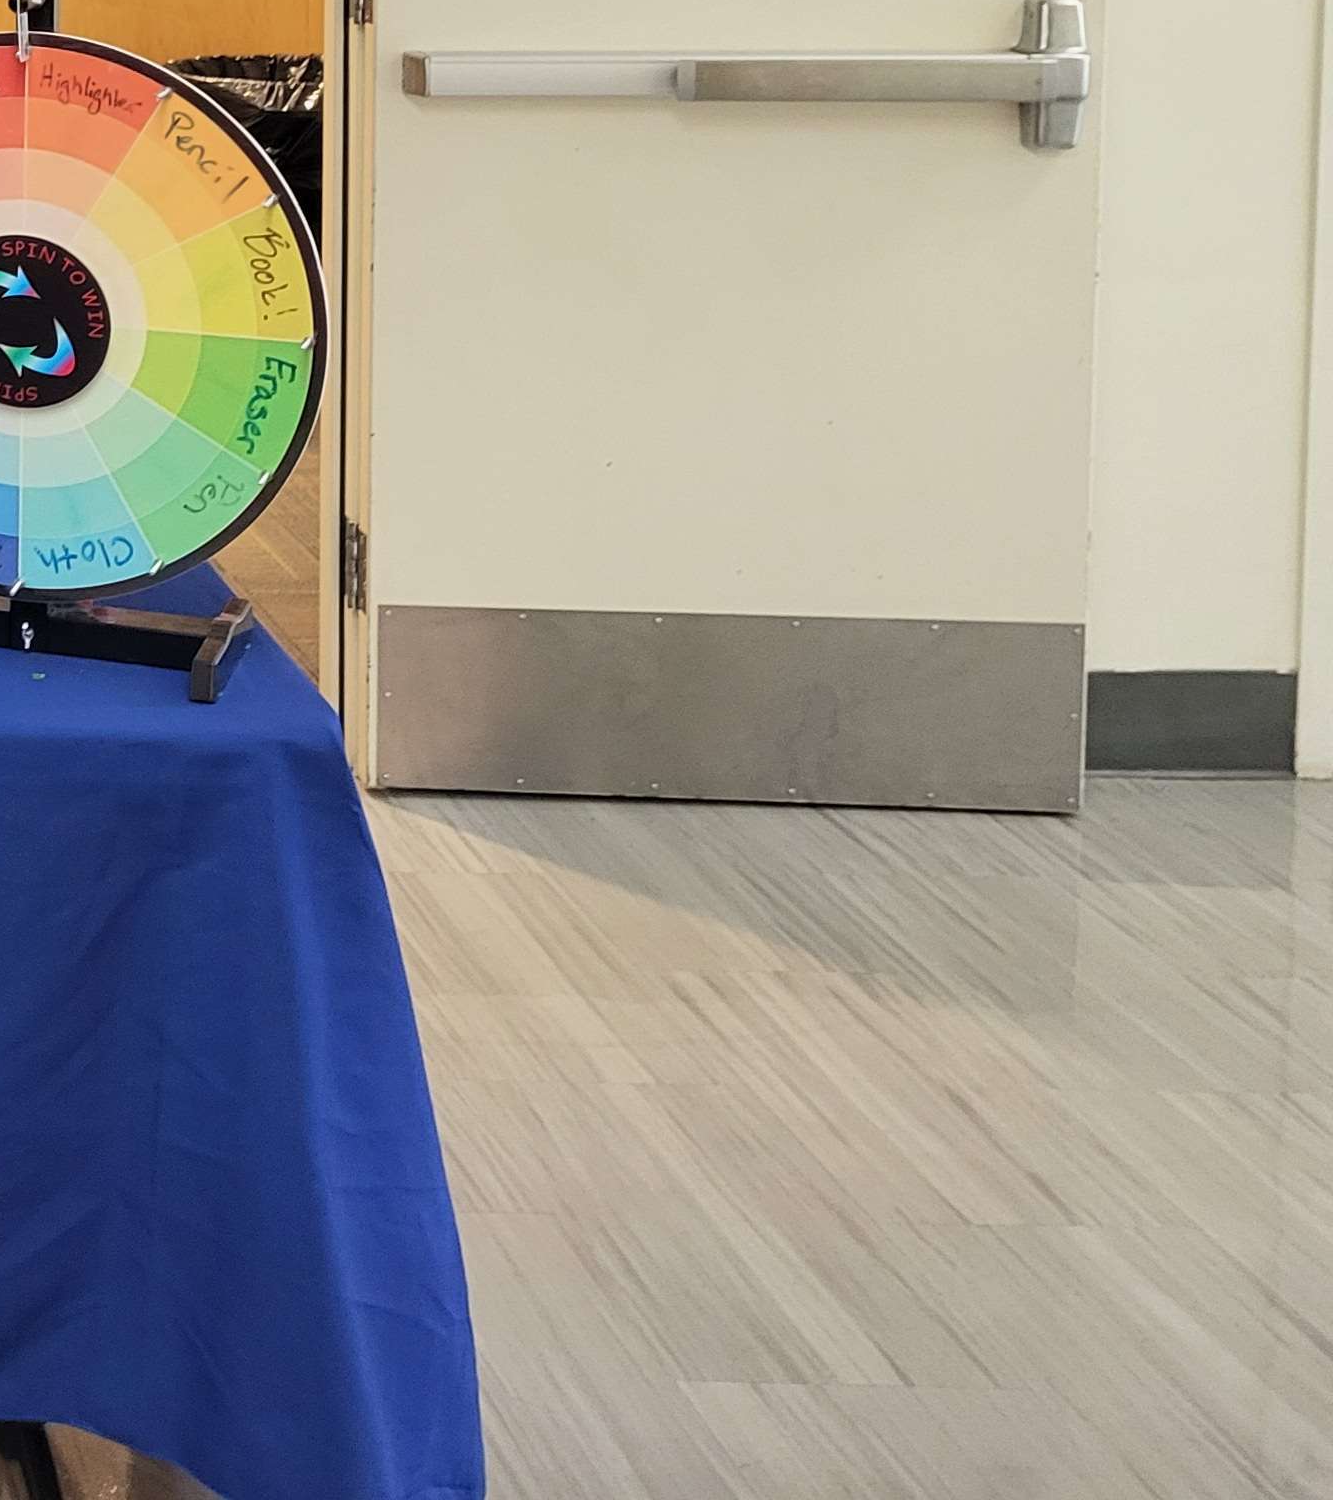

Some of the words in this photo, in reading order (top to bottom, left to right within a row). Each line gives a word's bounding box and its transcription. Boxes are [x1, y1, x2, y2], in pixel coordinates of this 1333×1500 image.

[163, 109, 250, 204] Pencil
[0, 240, 57, 264] SPIN
[61, 258, 87, 286] TO
[81, 290, 105, 339] WIN
[242, 226, 298, 323] Book!
[233, 355, 296, 459] Eraser
[182, 472, 247, 514] Pen
[35, 534, 136, 569] Cloth
